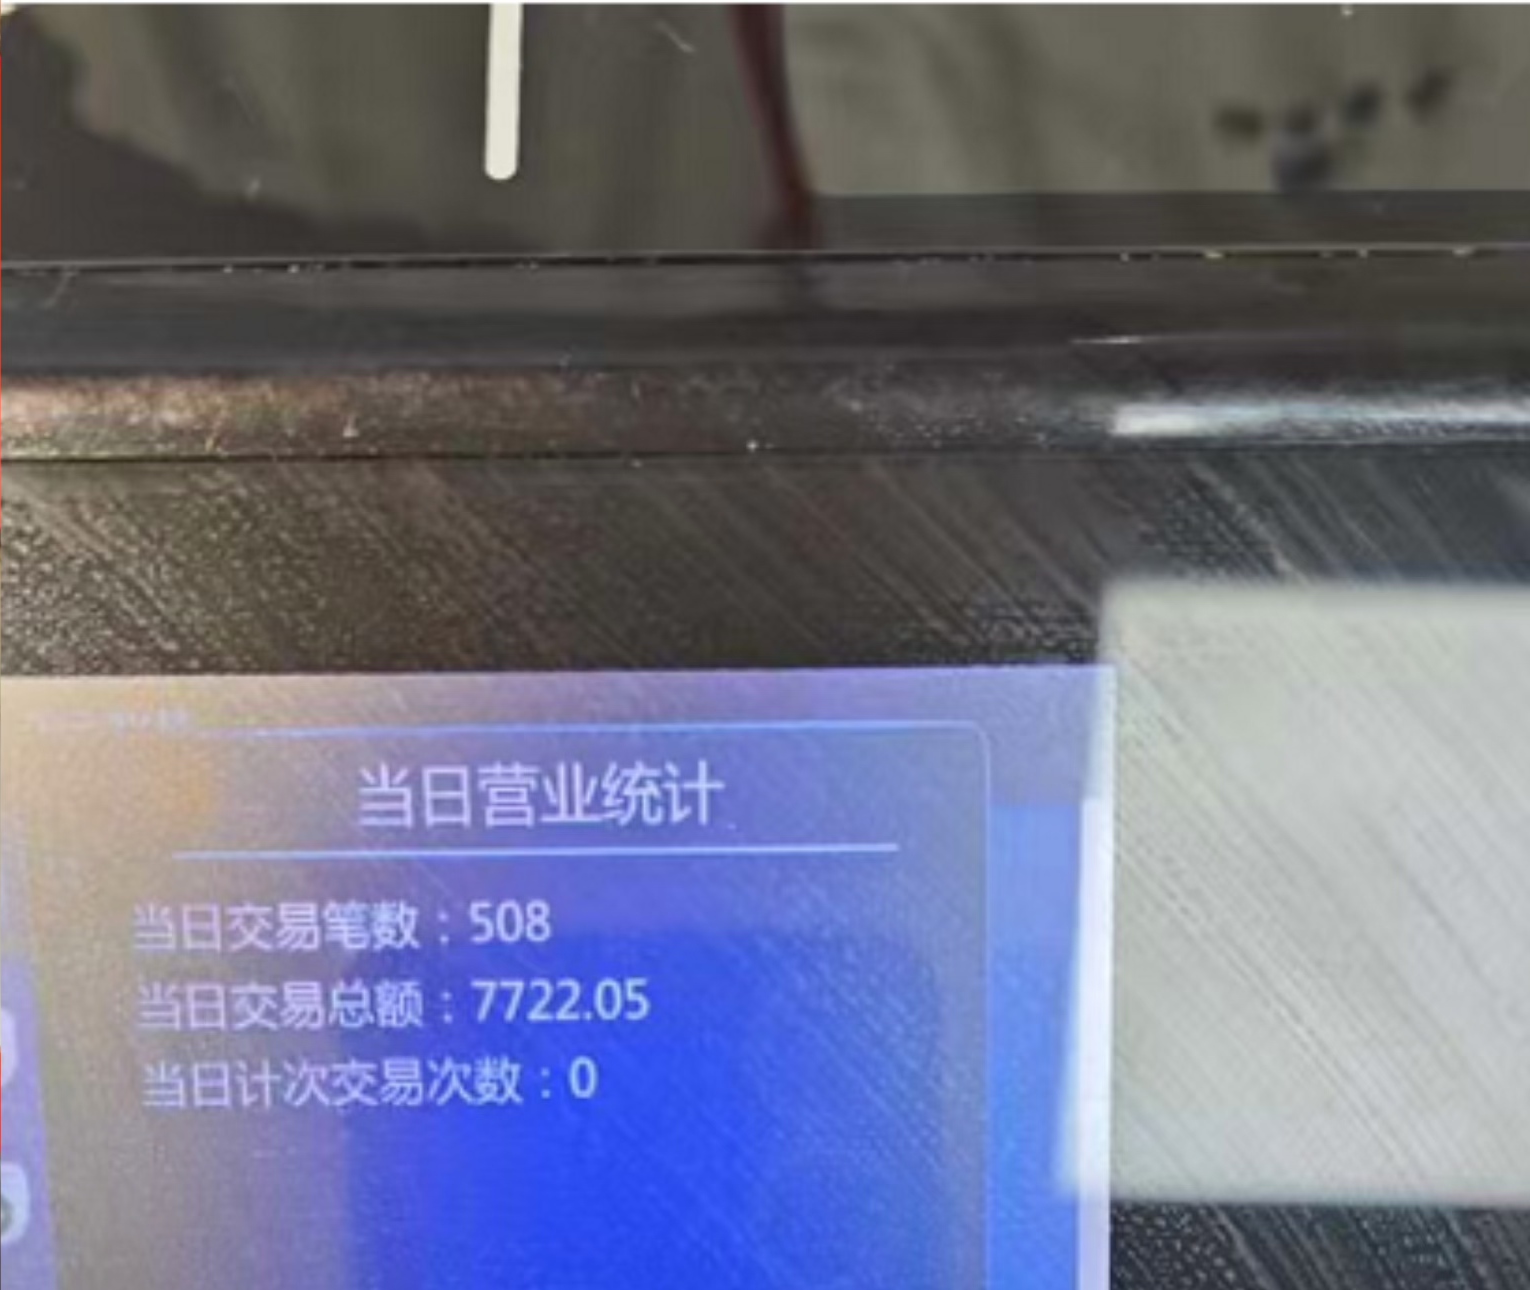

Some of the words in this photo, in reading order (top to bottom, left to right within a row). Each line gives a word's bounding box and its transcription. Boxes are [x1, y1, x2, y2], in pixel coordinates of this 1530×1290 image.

[355, 761, 726, 830] 当日营业统计
[133, 899, 553, 954] 当日交易笔数：508
[136, 977, 652, 1032] 当日交易总额：7722.05
[142, 1055, 599, 1110] 当日计次交易次数：0
